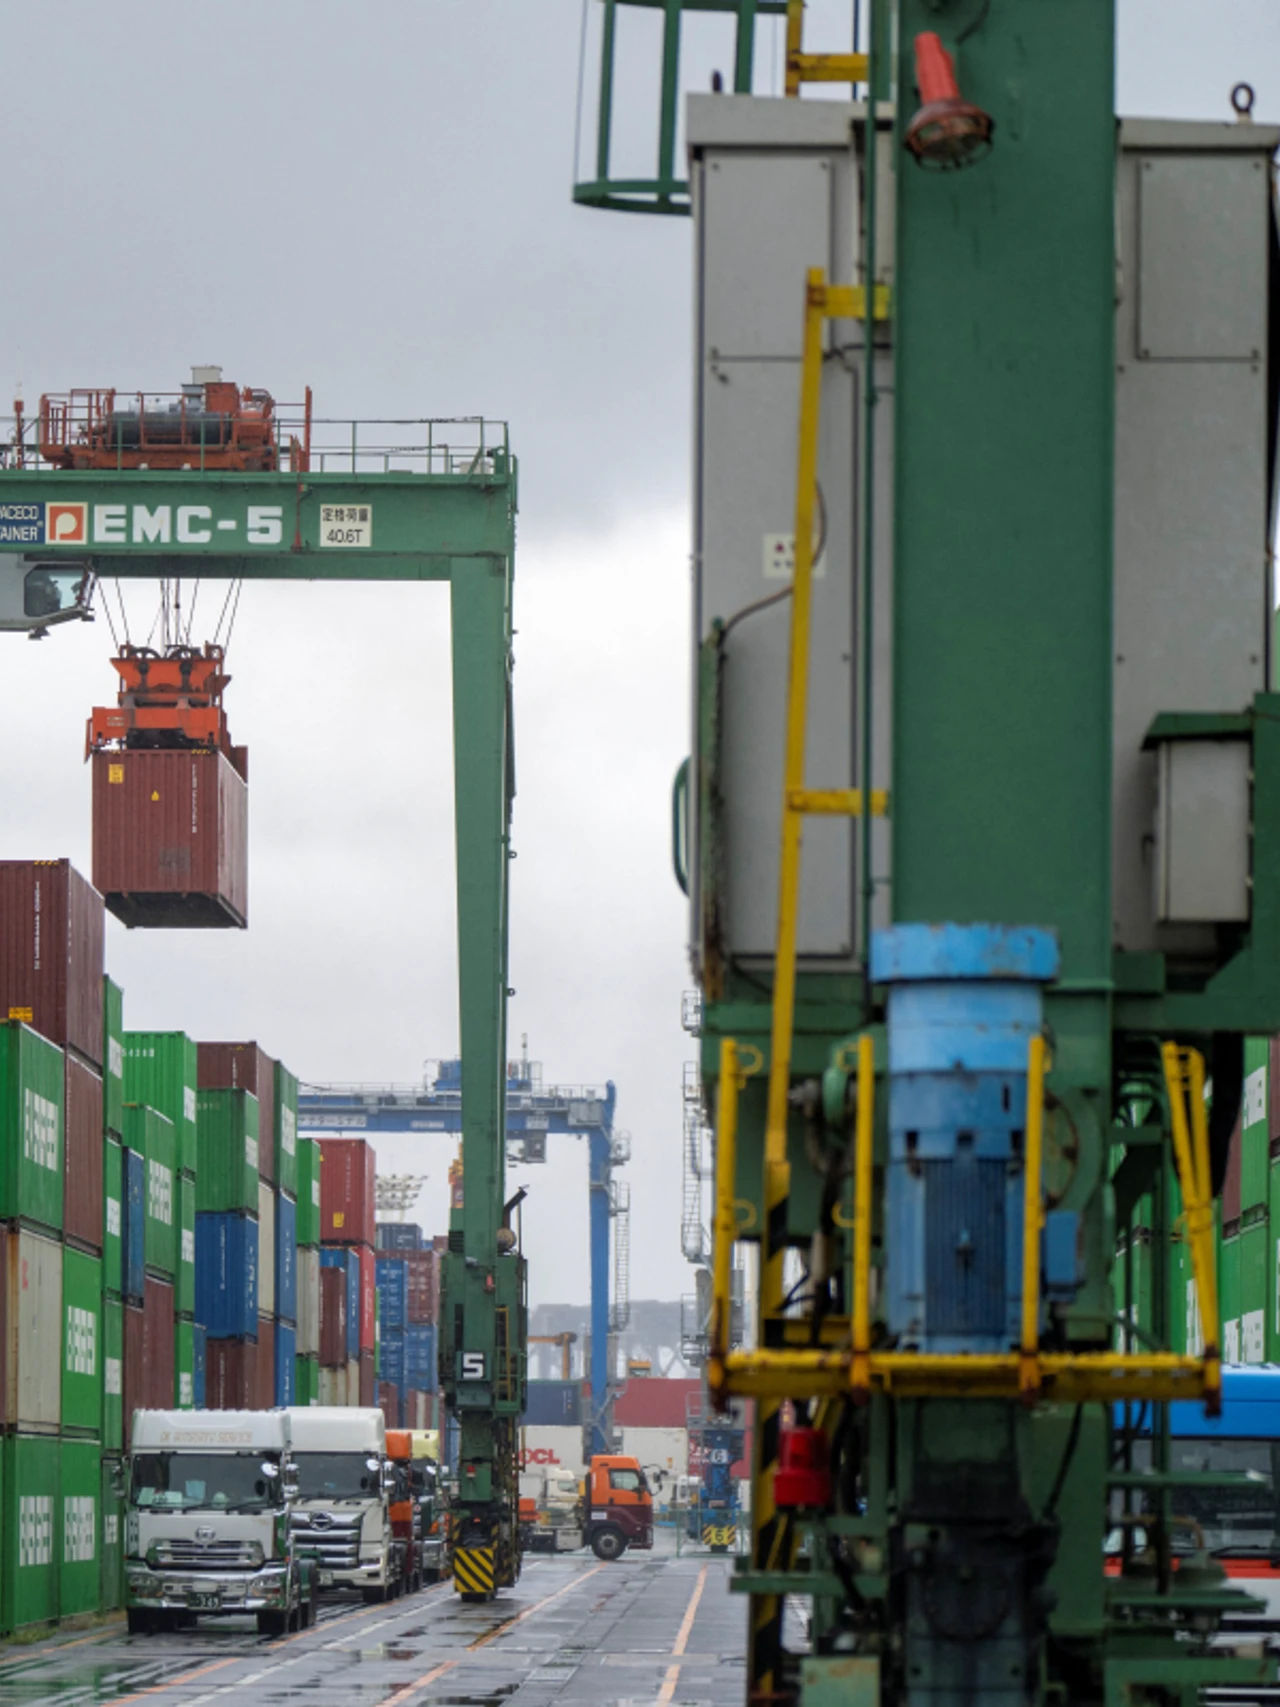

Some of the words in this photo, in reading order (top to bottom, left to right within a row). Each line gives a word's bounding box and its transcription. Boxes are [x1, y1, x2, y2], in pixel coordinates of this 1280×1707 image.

[93, 505, 284, 543] EMC-5
[326, 528, 363, 543] 40.6T
[463, 1353, 483, 1379] 5
[517, 1447, 560, 1465] OCL
